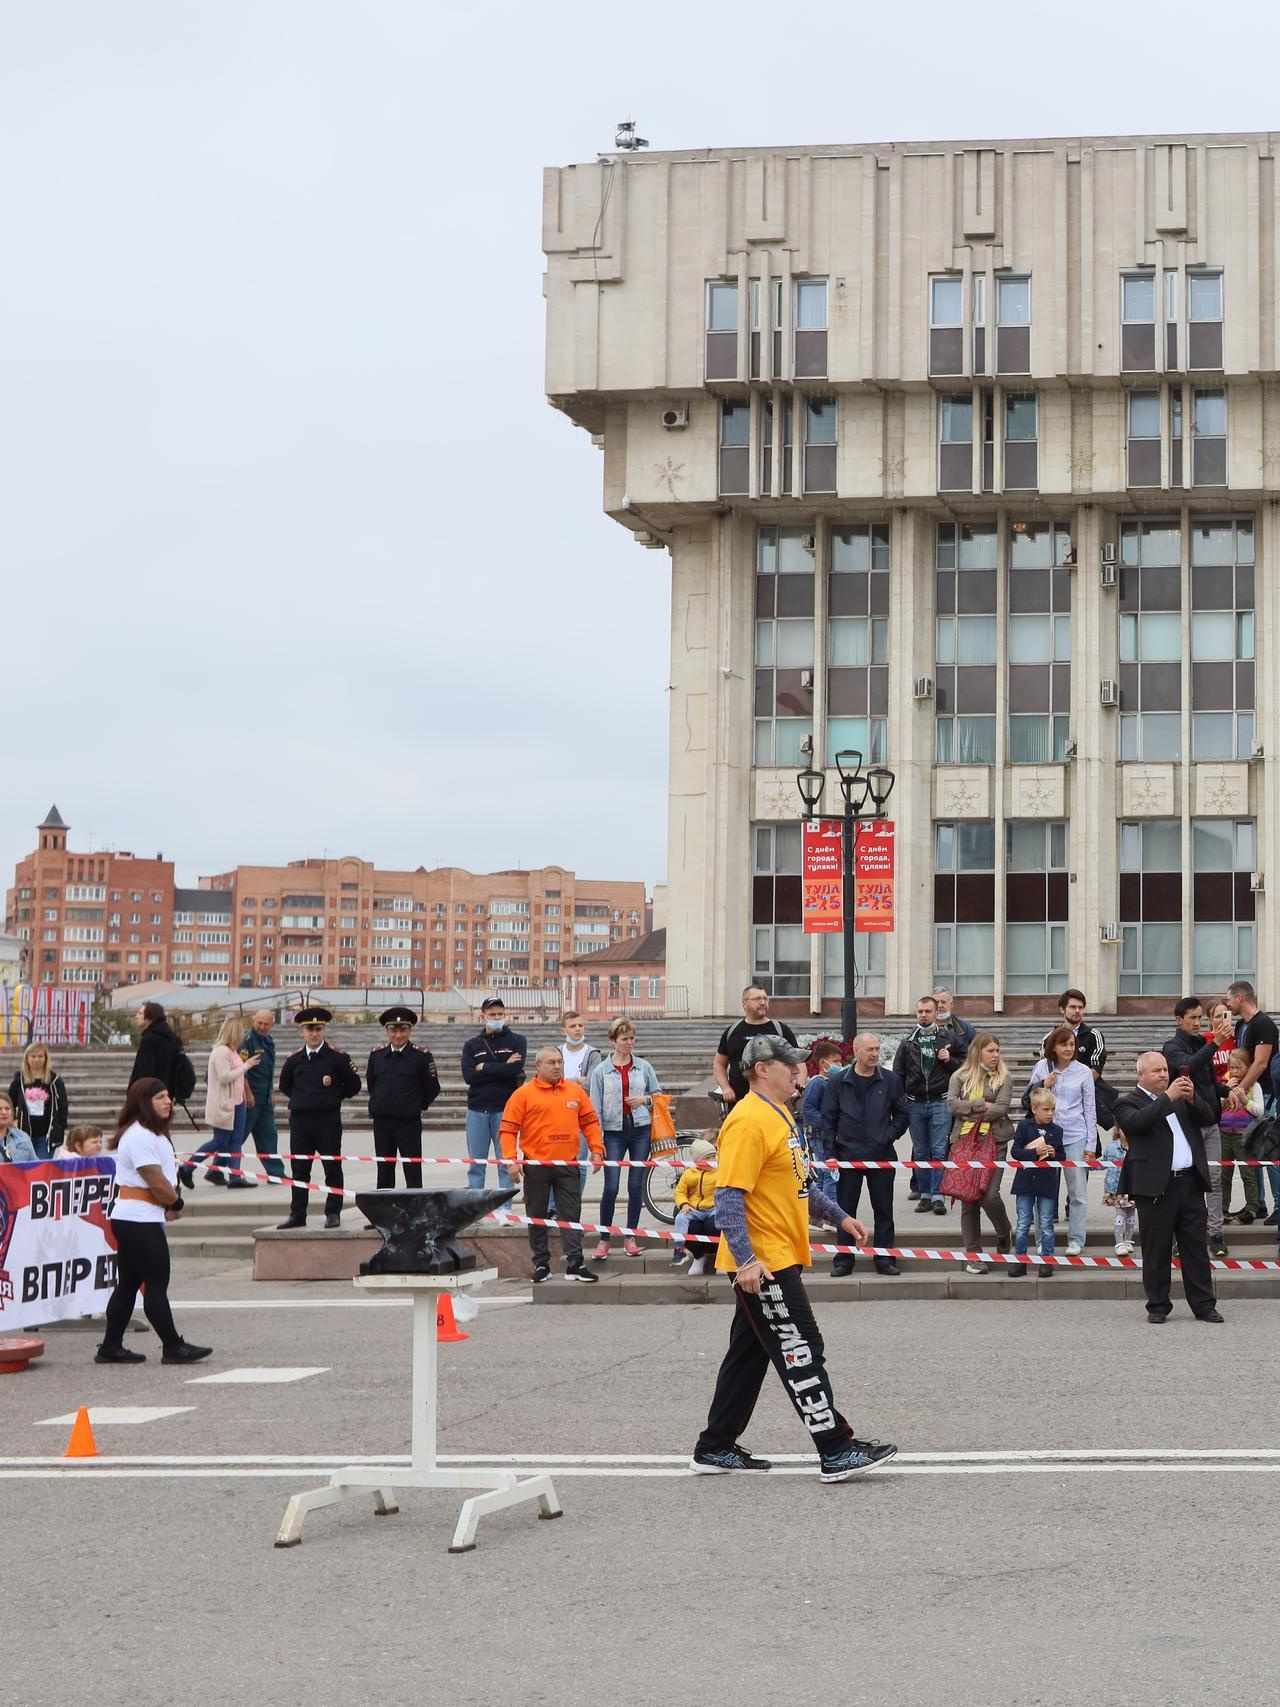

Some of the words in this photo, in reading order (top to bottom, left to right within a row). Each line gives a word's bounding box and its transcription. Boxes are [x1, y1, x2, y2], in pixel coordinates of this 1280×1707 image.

[815, 846, 835, 854] днём
[807, 855, 838, 863] города,
[807, 863, 838, 871] туляки!
[860, 863, 891, 871] туляки!
[804, 882, 839, 895] ТУЛА
[857, 882, 892, 895] ТУЛА
[788, 1376, 836, 1434] GET
